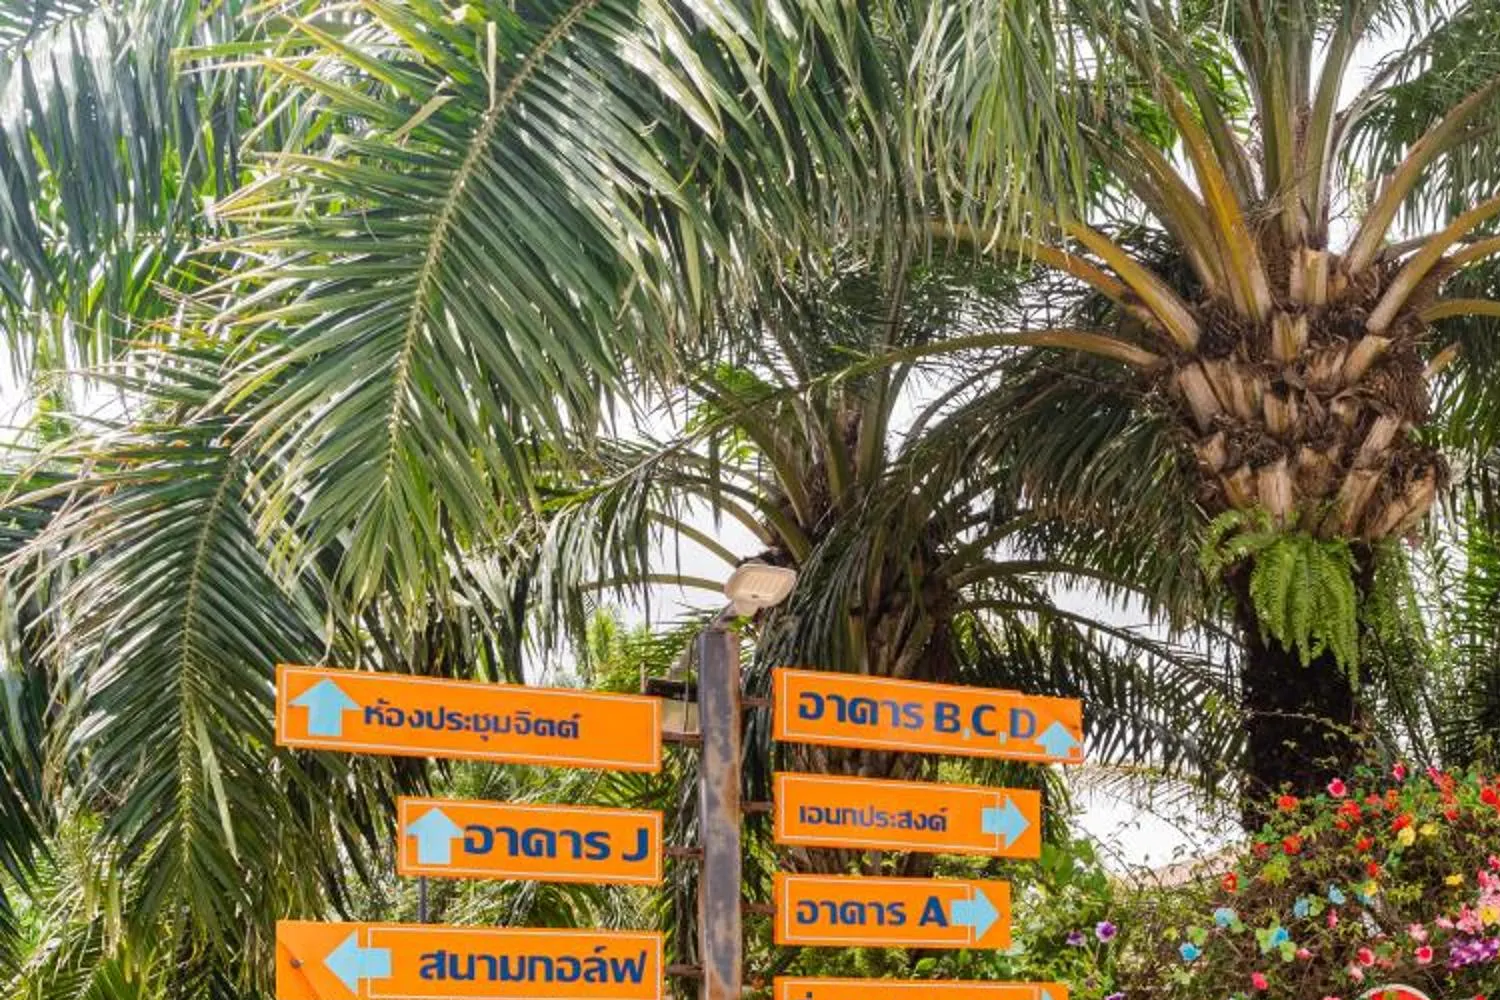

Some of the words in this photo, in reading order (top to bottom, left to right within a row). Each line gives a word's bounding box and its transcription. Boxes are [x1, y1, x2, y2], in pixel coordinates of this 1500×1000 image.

[798, 691, 925, 730] อาคาร
[799, 804, 948, 832] เอนกประสงค์
[463, 824, 611, 861] อาคาร
[621, 827, 649, 863] J
[796, 898, 907, 927] อาคาร
[918, 895, 949, 928] A
[419, 945, 647, 984] สนามกอล์ฟ
